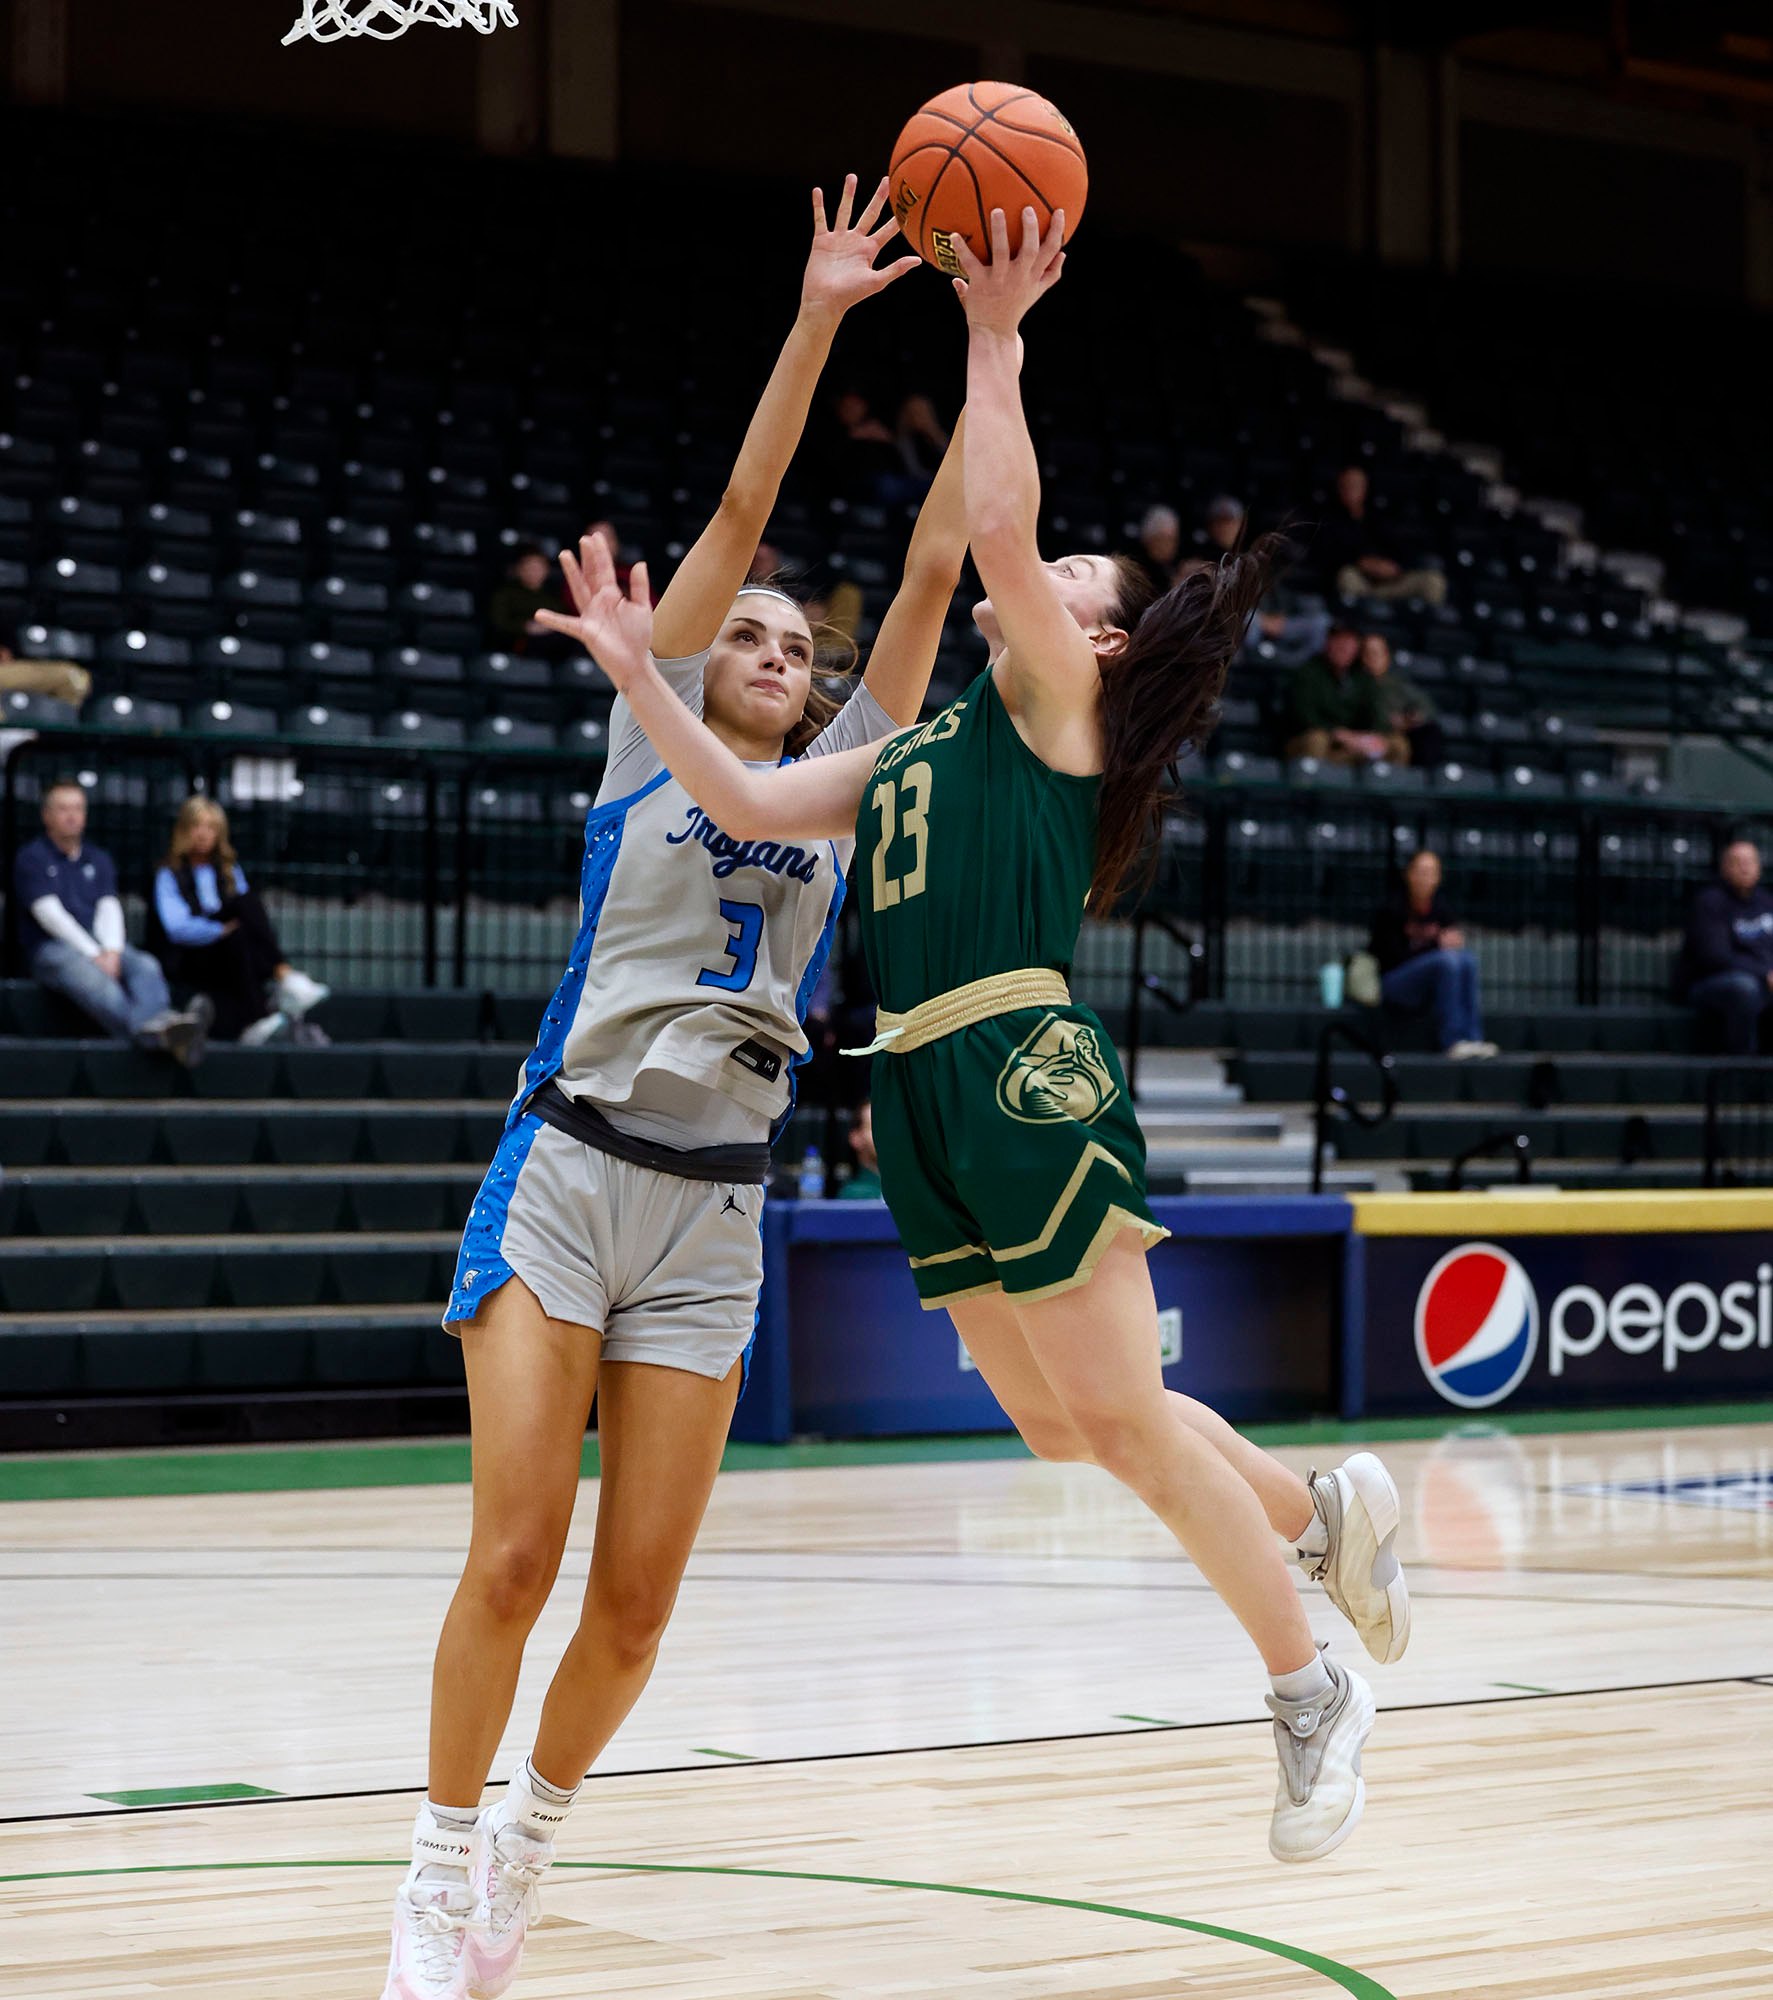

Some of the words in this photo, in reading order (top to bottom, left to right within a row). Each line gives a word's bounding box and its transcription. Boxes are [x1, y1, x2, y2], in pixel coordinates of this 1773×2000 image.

[666, 806, 819, 884] Trojans
[872, 761, 933, 913] 23
[696, 897, 764, 993] 3
[764, 1059, 775, 1072] M
[1550, 1263, 1772, 1376] pepsi
